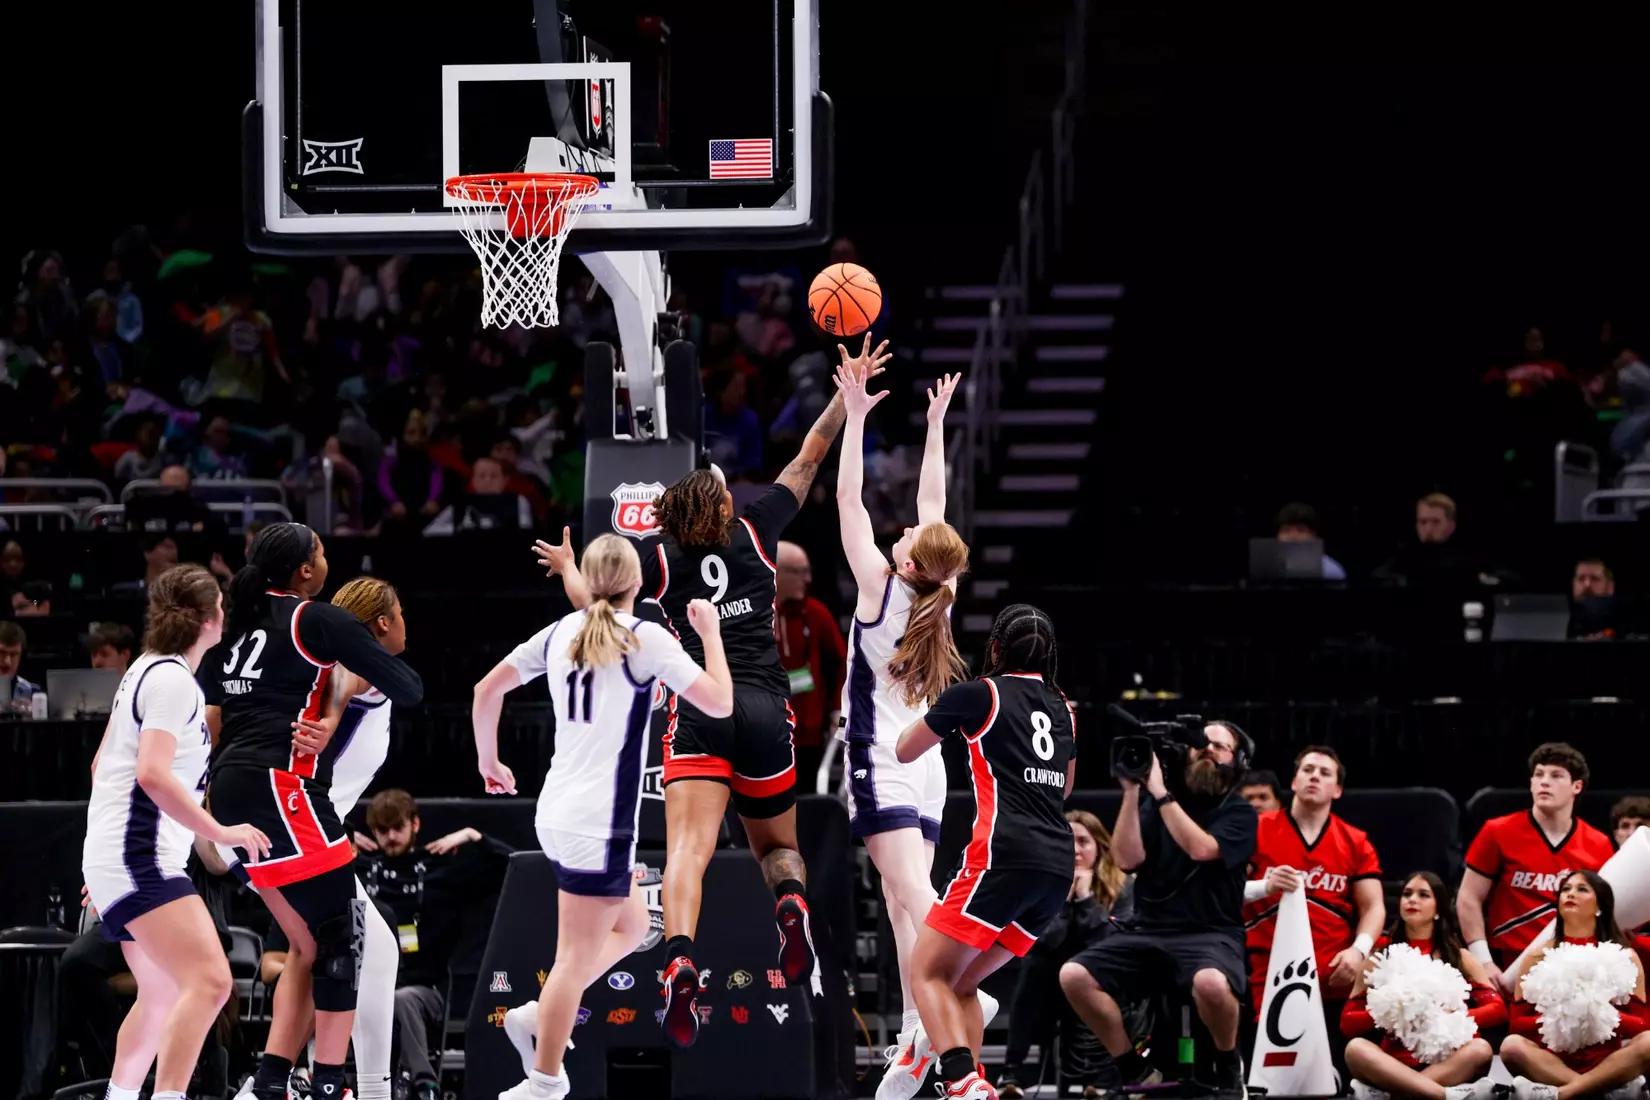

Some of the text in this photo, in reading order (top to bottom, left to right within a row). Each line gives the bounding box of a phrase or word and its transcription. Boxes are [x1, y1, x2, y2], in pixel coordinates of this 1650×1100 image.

[623, 505, 657, 526] 66
[700, 554, 729, 604] 9
[715, 598, 754, 620] ANDER
[223, 629, 267, 679] 32
[566, 670, 595, 724] 11
[1030, 711, 1055, 761] 8
[1024, 767, 1065, 788] CRAWFORD
[490, 971, 512, 992] A
[1266, 982, 1312, 1047] C
